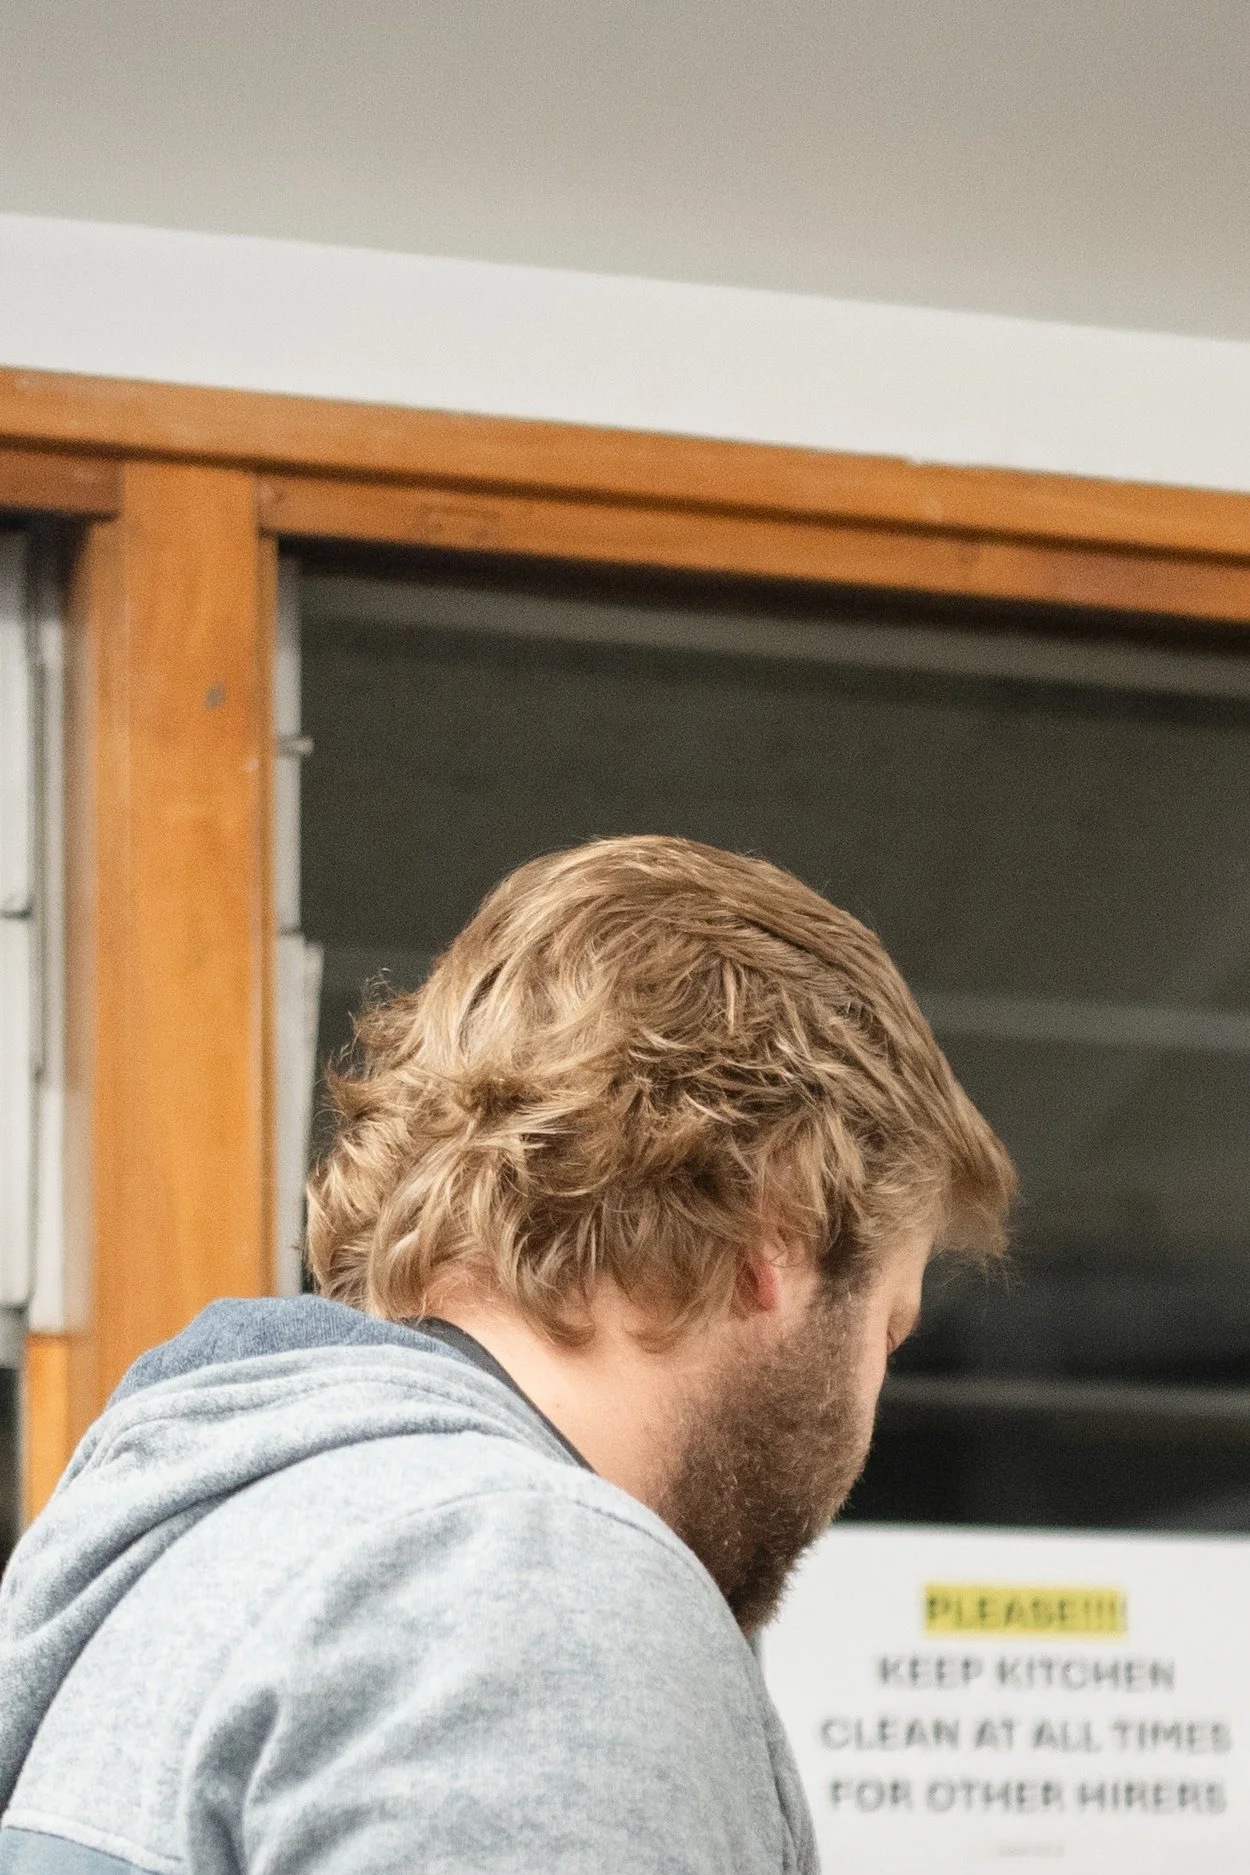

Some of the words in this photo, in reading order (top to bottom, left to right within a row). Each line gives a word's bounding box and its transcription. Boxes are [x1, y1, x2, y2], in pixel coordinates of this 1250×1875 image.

[876, 1654, 982, 1692] KEEP
[998, 1656, 1177, 1694] KITCHEN
[818, 1717, 960, 1753] CLEAN
[974, 1718, 1018, 1753] AT
[1031, 1719, 1100, 1755] ALL
[1112, 1718, 1233, 1756] TIMES
[829, 1779, 914, 1815] FOR
[925, 1780, 1066, 1815] OTHER
[1078, 1781, 1229, 1816] HIRERS
